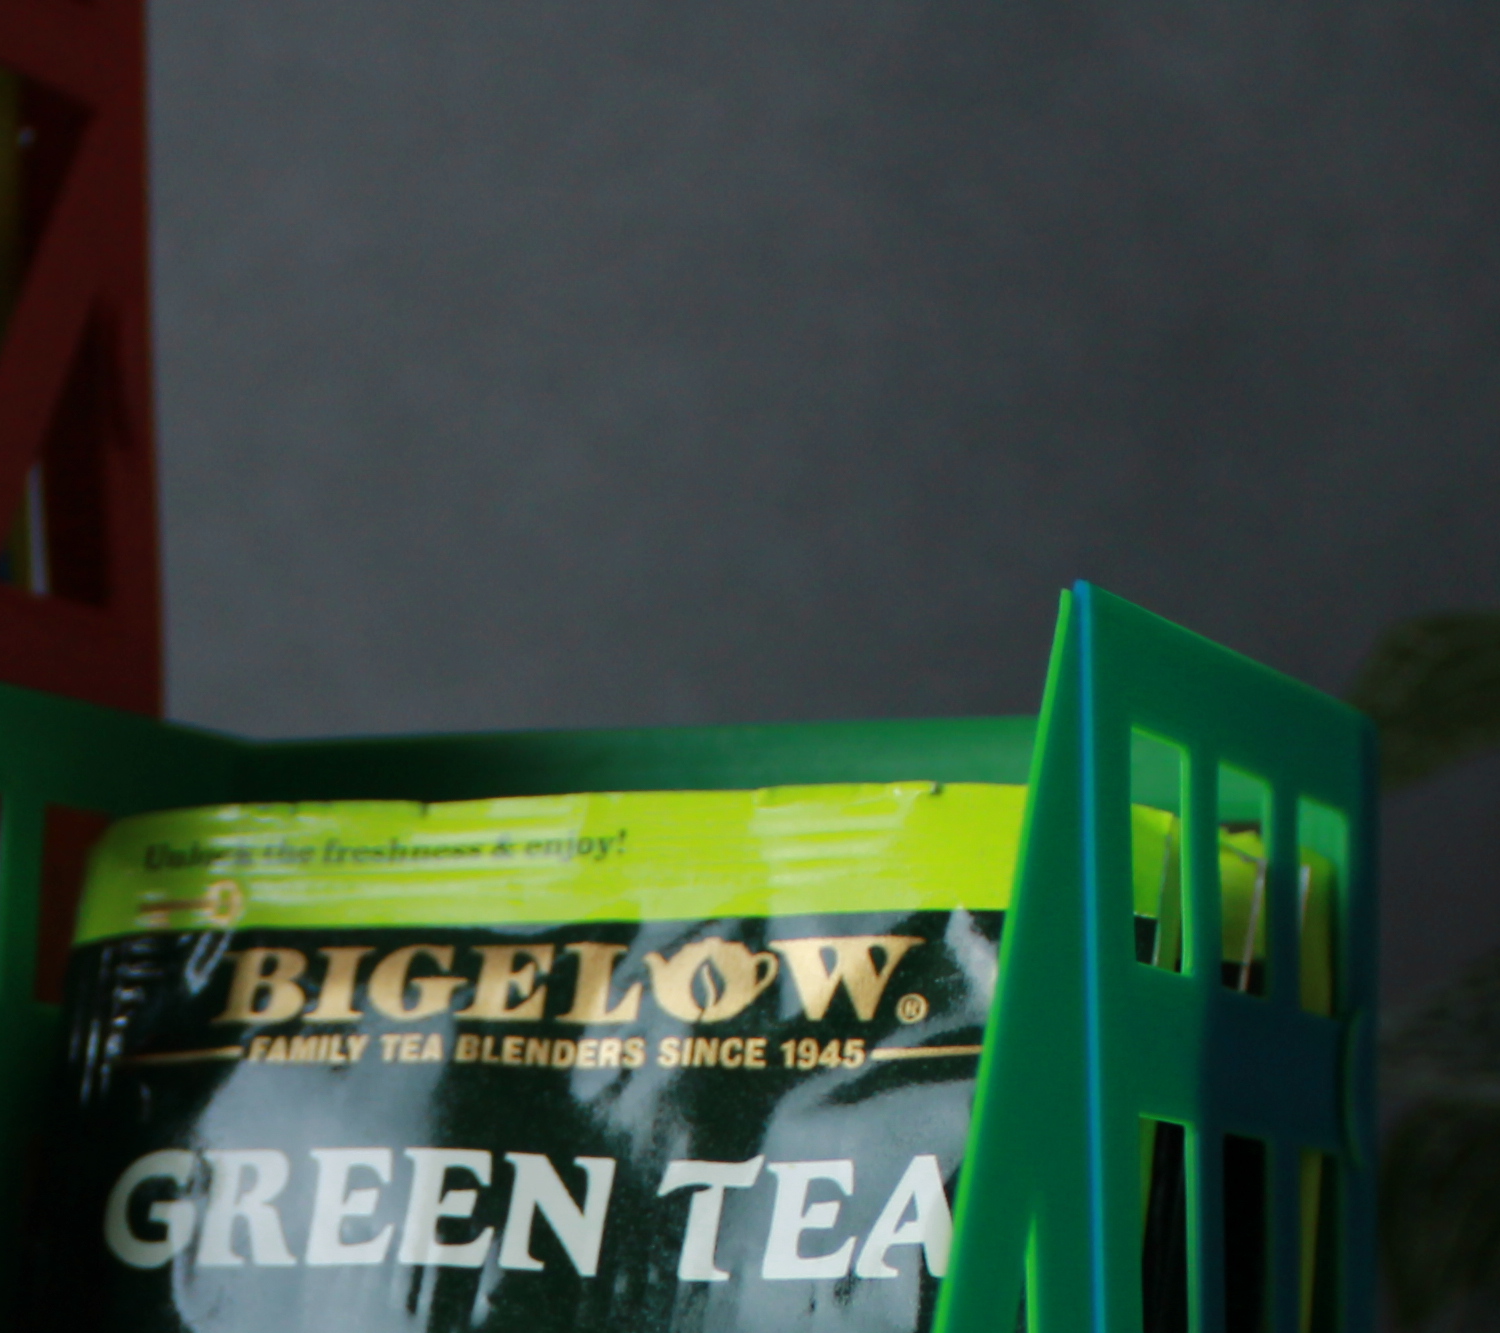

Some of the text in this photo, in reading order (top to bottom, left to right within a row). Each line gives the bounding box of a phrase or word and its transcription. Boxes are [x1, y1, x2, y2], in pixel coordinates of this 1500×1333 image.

[263, 838, 314, 866] the
[324, 836, 481, 865] freshness
[490, 838, 517, 860] &
[524, 829, 627, 863] enjoy!
[244, 1034, 866, 1070] FAMILY TEA BLENDERS SINCE 1945
[104, 1147, 954, 1282] GREEN TEA
